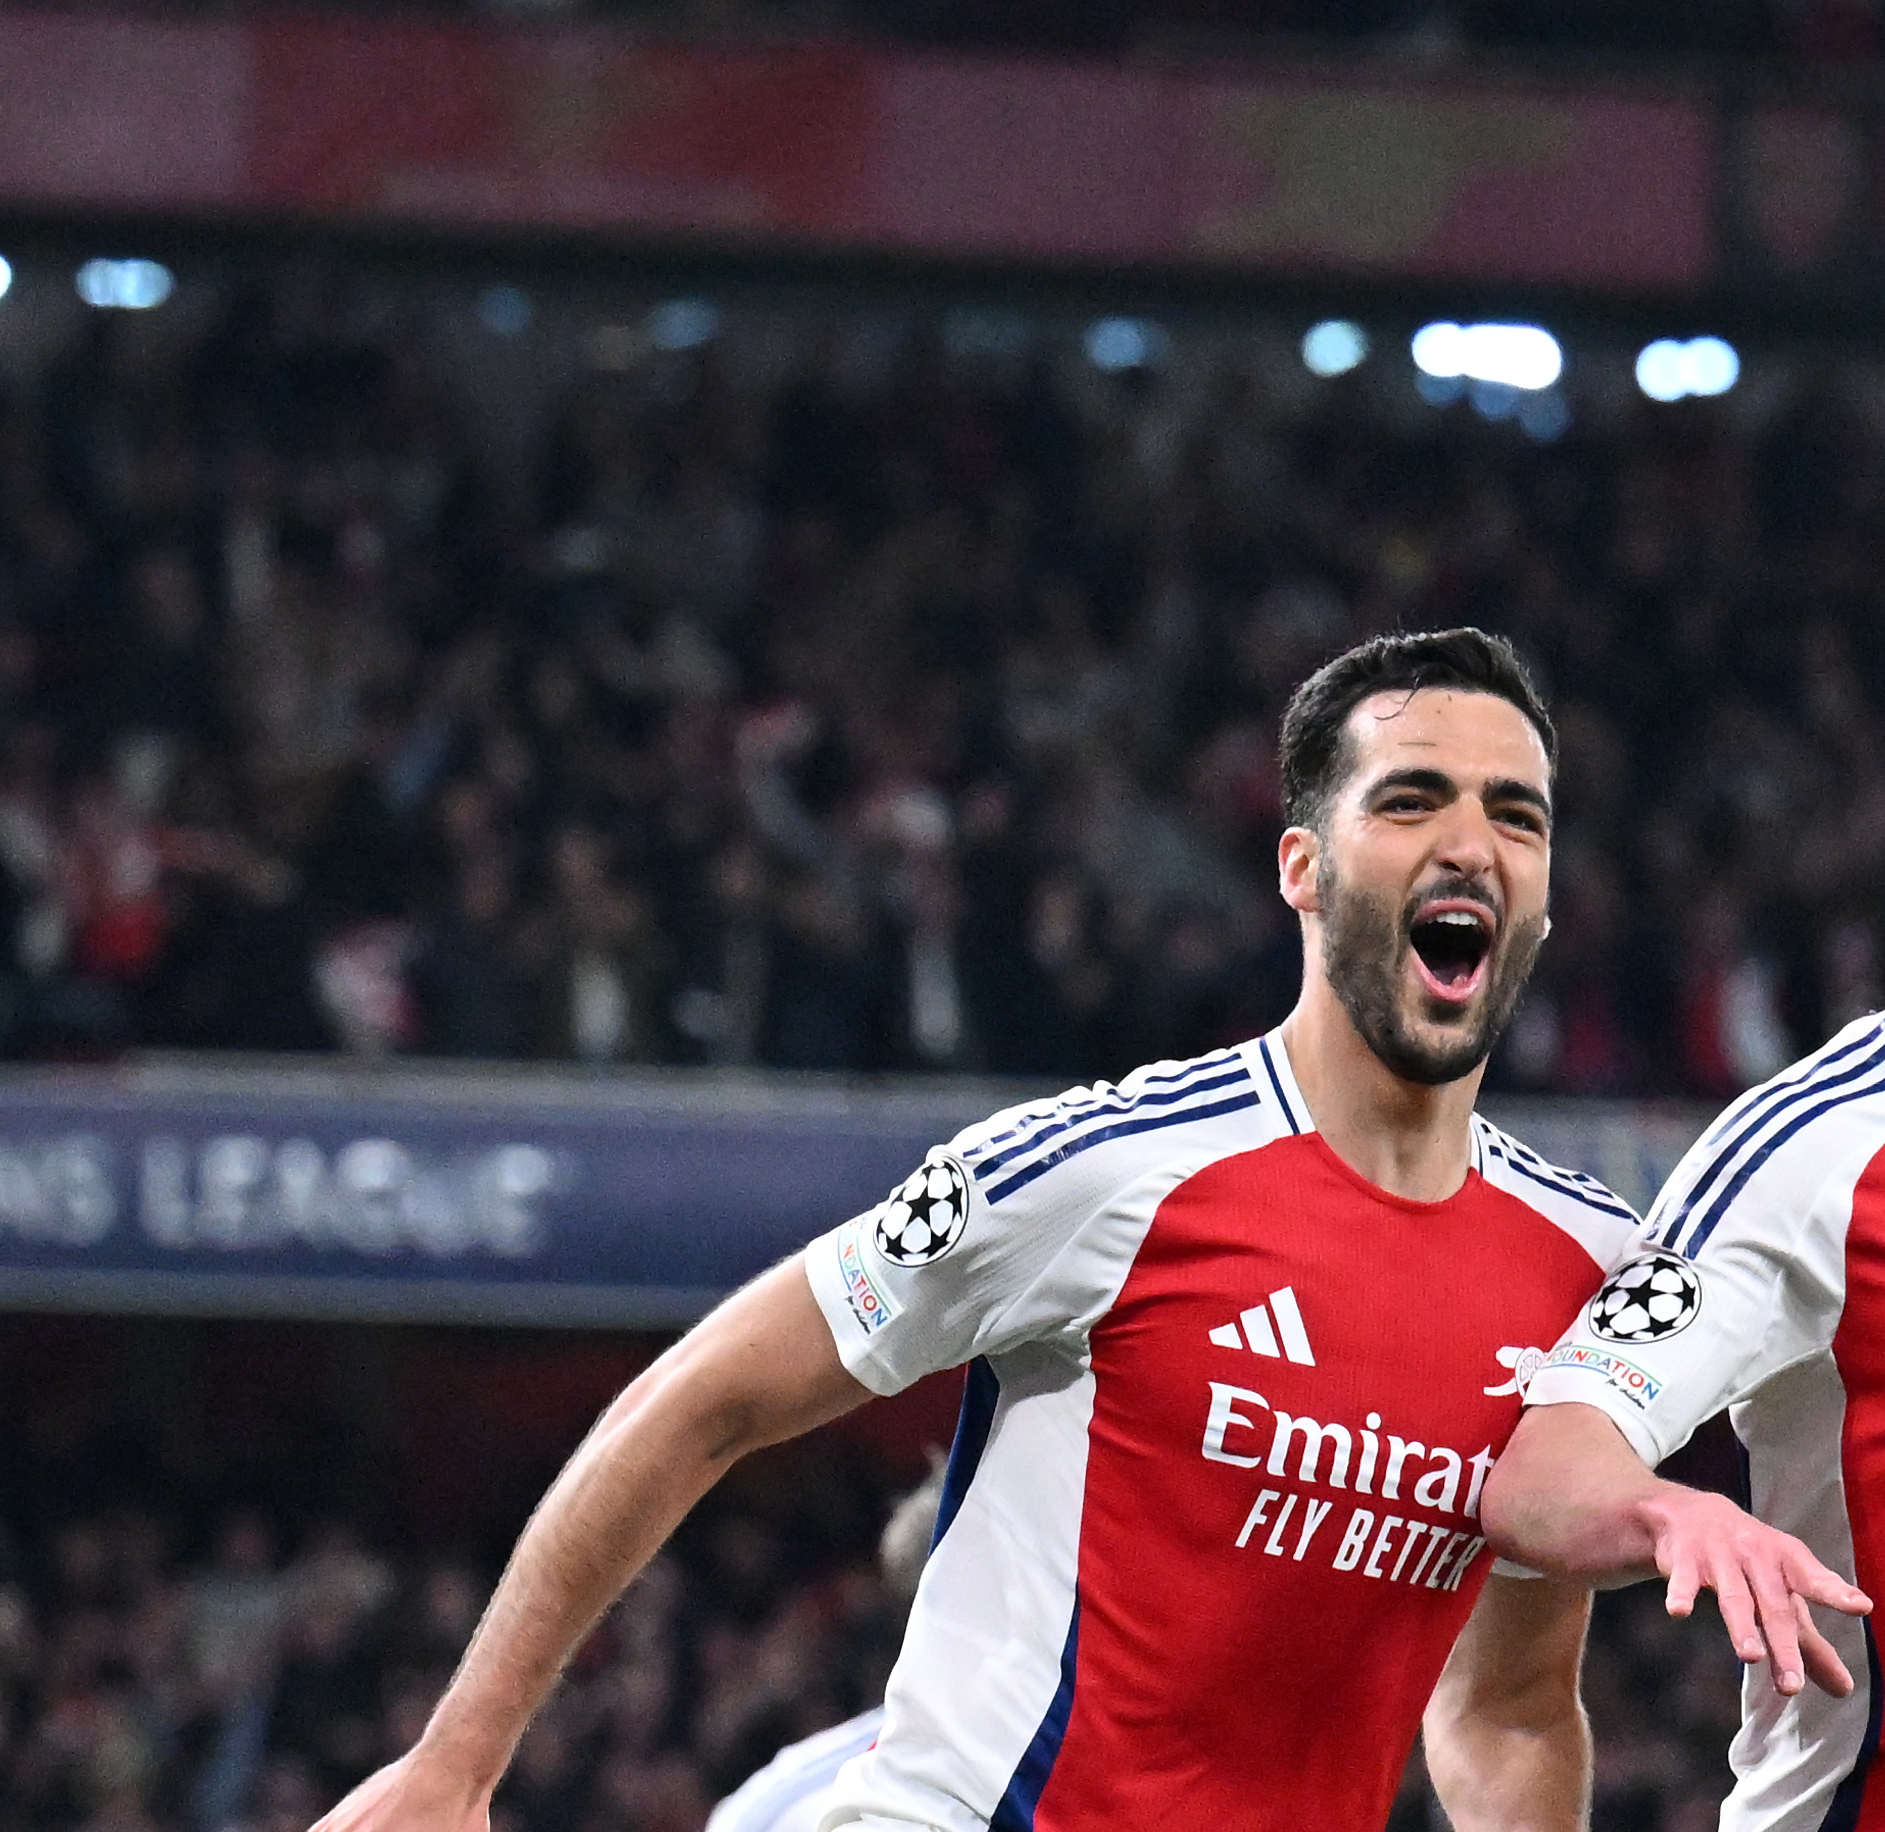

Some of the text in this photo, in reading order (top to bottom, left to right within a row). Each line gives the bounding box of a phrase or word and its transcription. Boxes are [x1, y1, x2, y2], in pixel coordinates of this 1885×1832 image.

[138, 1134, 556, 1260] LEAGUE
[1201, 1381, 1497, 1520] Emirat
[1235, 1488, 1486, 1592] FLY BETTER
